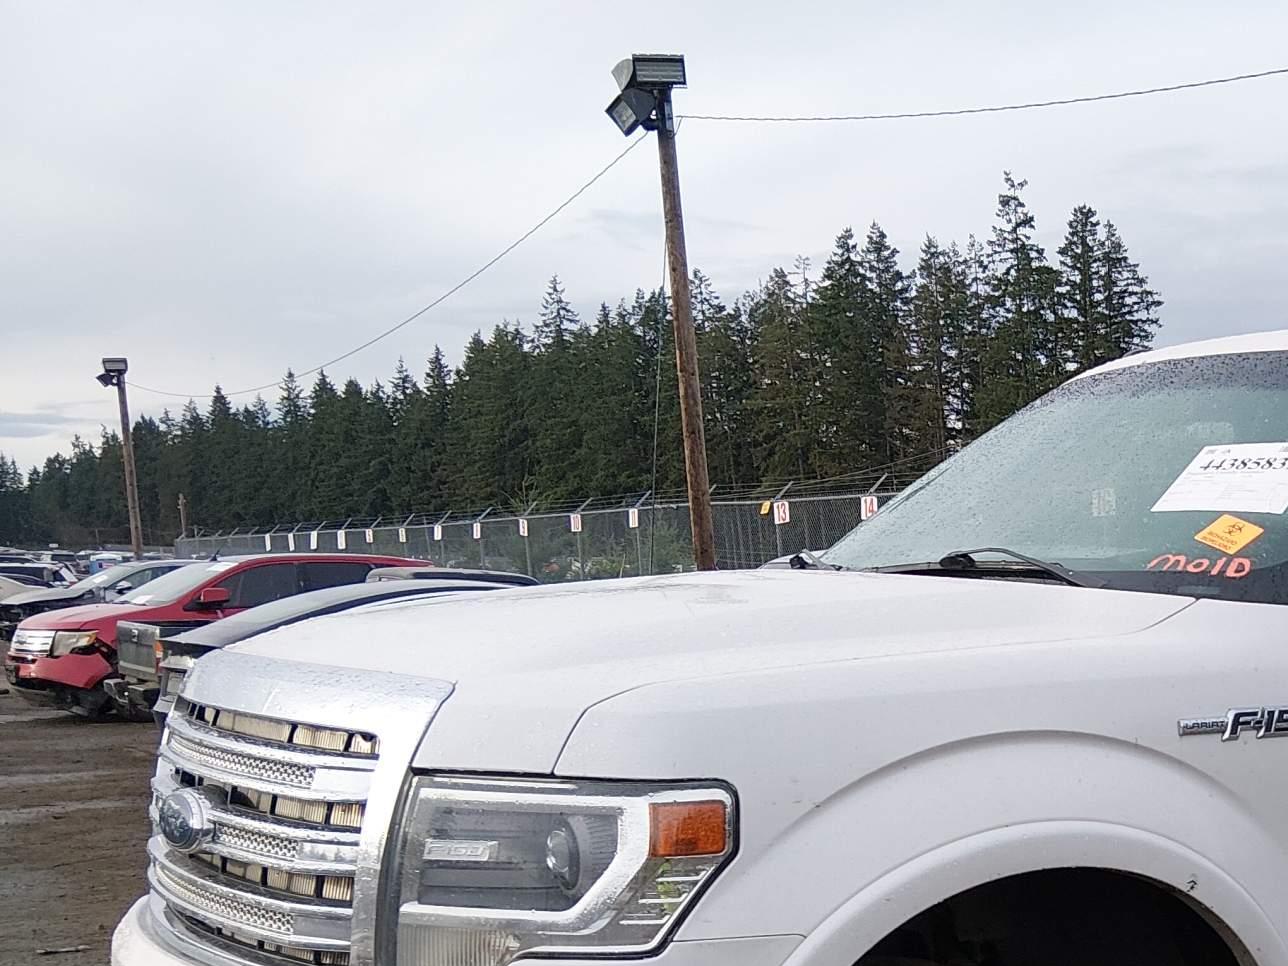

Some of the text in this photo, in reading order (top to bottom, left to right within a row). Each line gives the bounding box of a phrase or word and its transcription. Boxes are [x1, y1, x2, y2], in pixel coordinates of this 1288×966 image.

[775, 502, 788, 522] 13
[864, 498, 876, 518] 14
[1184, 720, 1227, 731] LARIAT
